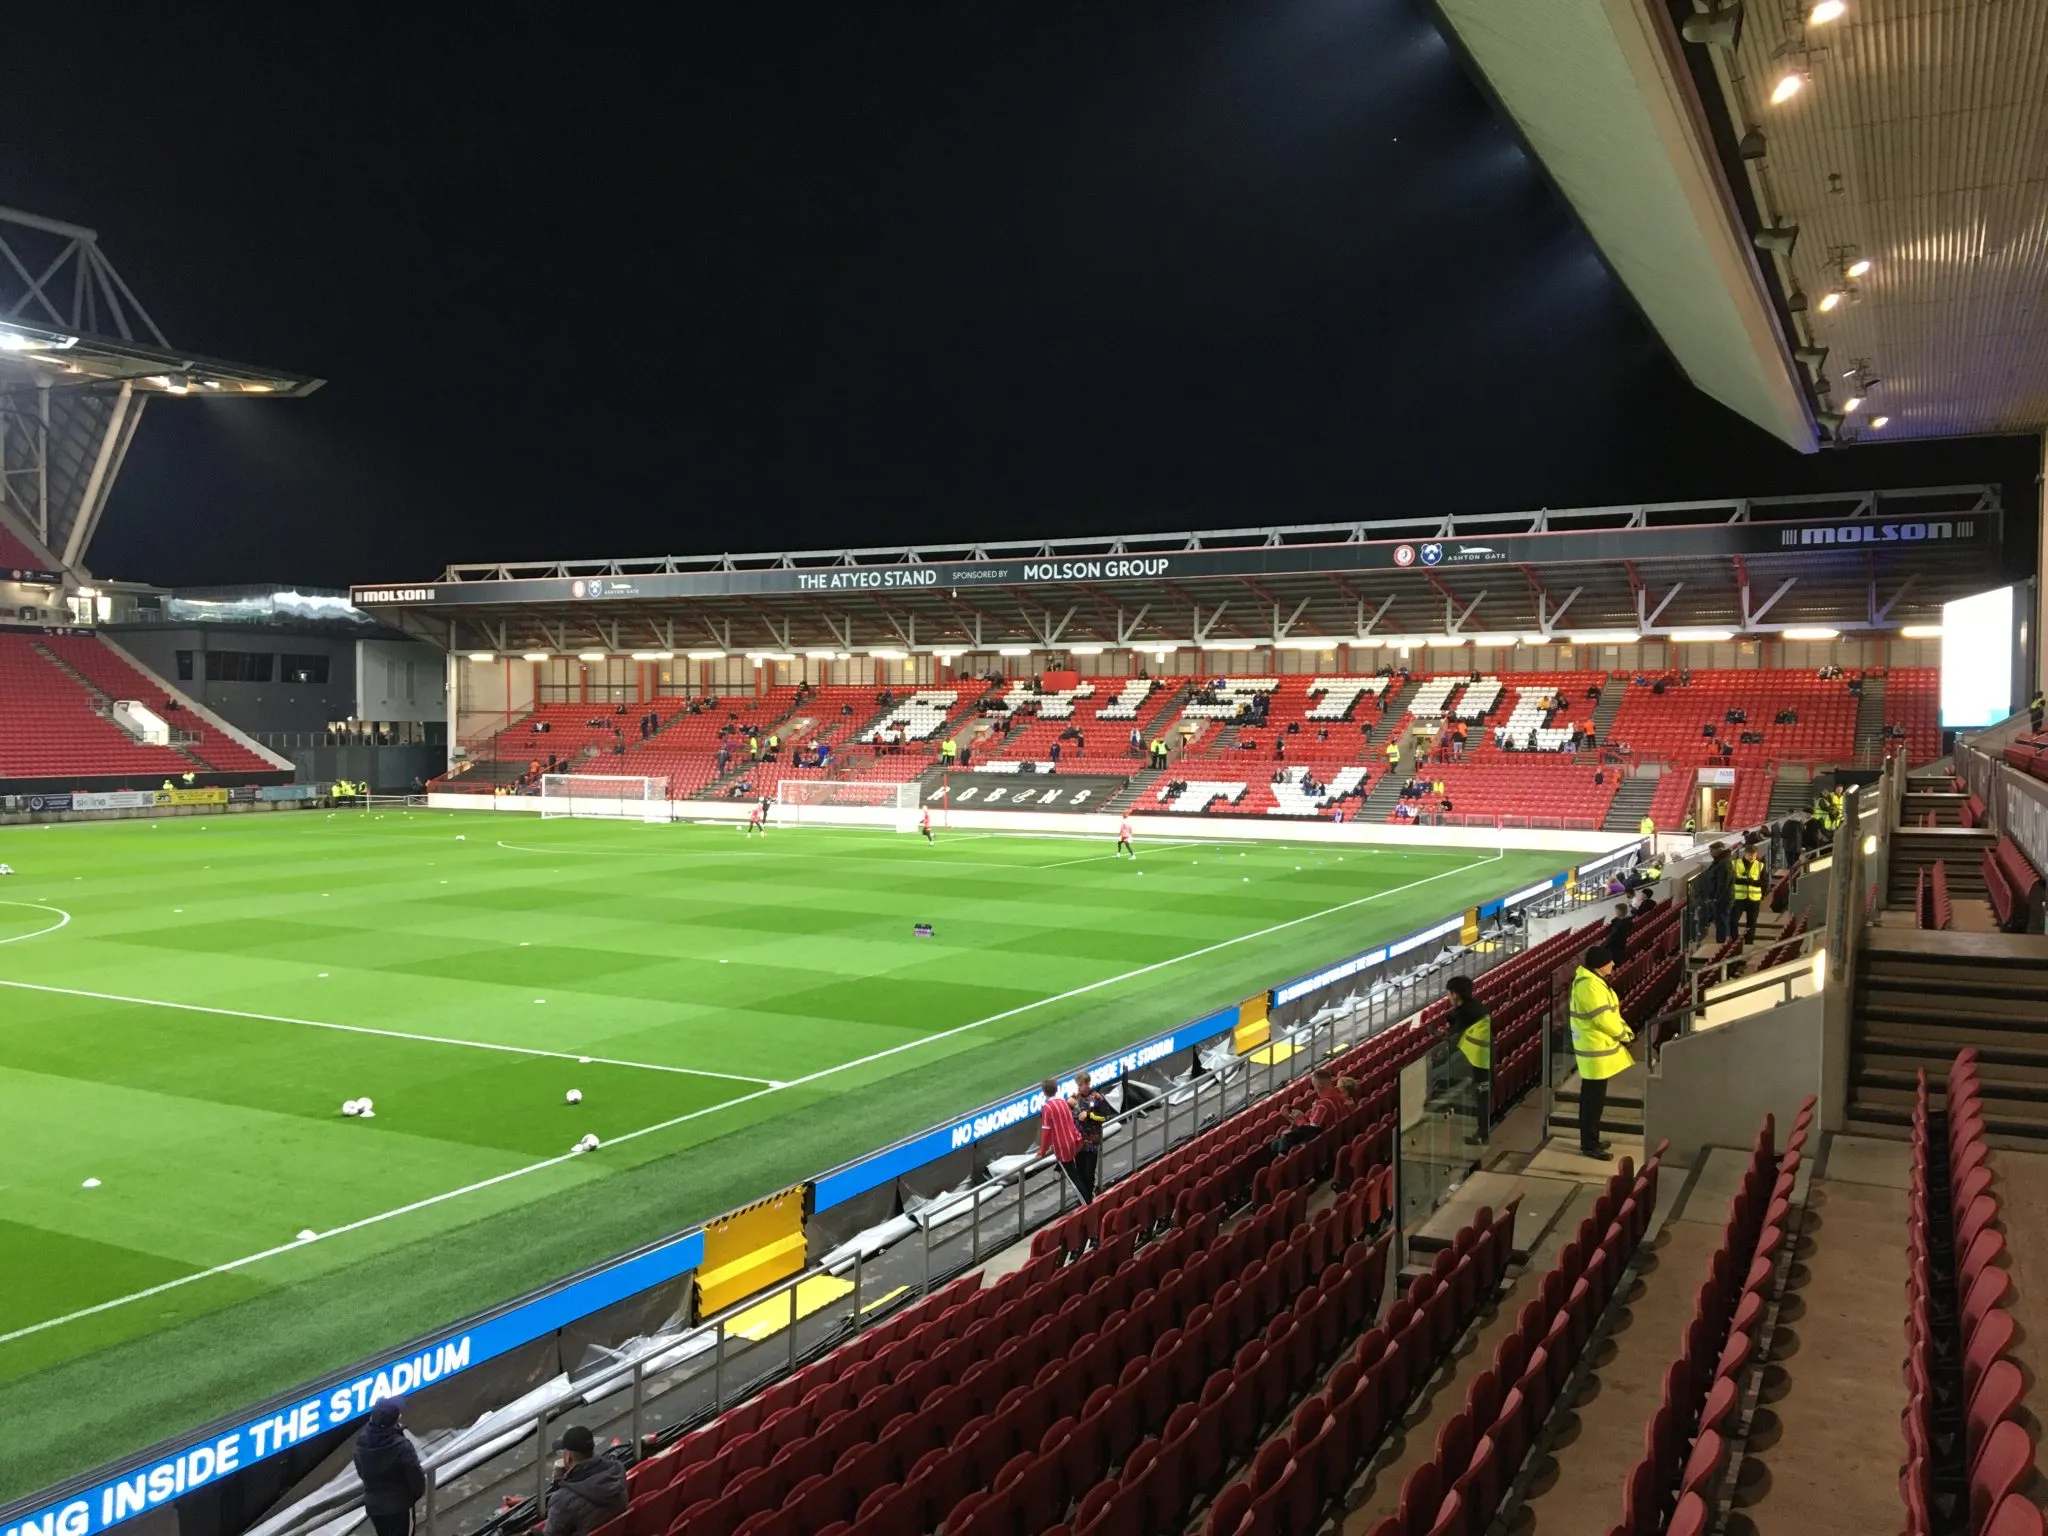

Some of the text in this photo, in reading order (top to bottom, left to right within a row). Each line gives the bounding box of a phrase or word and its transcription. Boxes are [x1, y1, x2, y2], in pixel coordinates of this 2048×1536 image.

[1801, 522, 1953, 545] MOLSON
[798, 570, 936, 589] THE ATYEO STAND
[952, 570, 1008, 580] SPONSORED BY
[1023, 559, 1169, 580] MOLSON GROUP
[363, 589, 426, 602] MOLSON
[951, 1123, 972, 1149] NO
[973, 1099, 1029, 1139] SMOKING
[1137, 1036, 1174, 1067] STADIUM
[102, 1433, 240, 1526] INSIDE
[249, 1400, 321, 1457] THE
[330, 1336, 471, 1423] STADIUM
